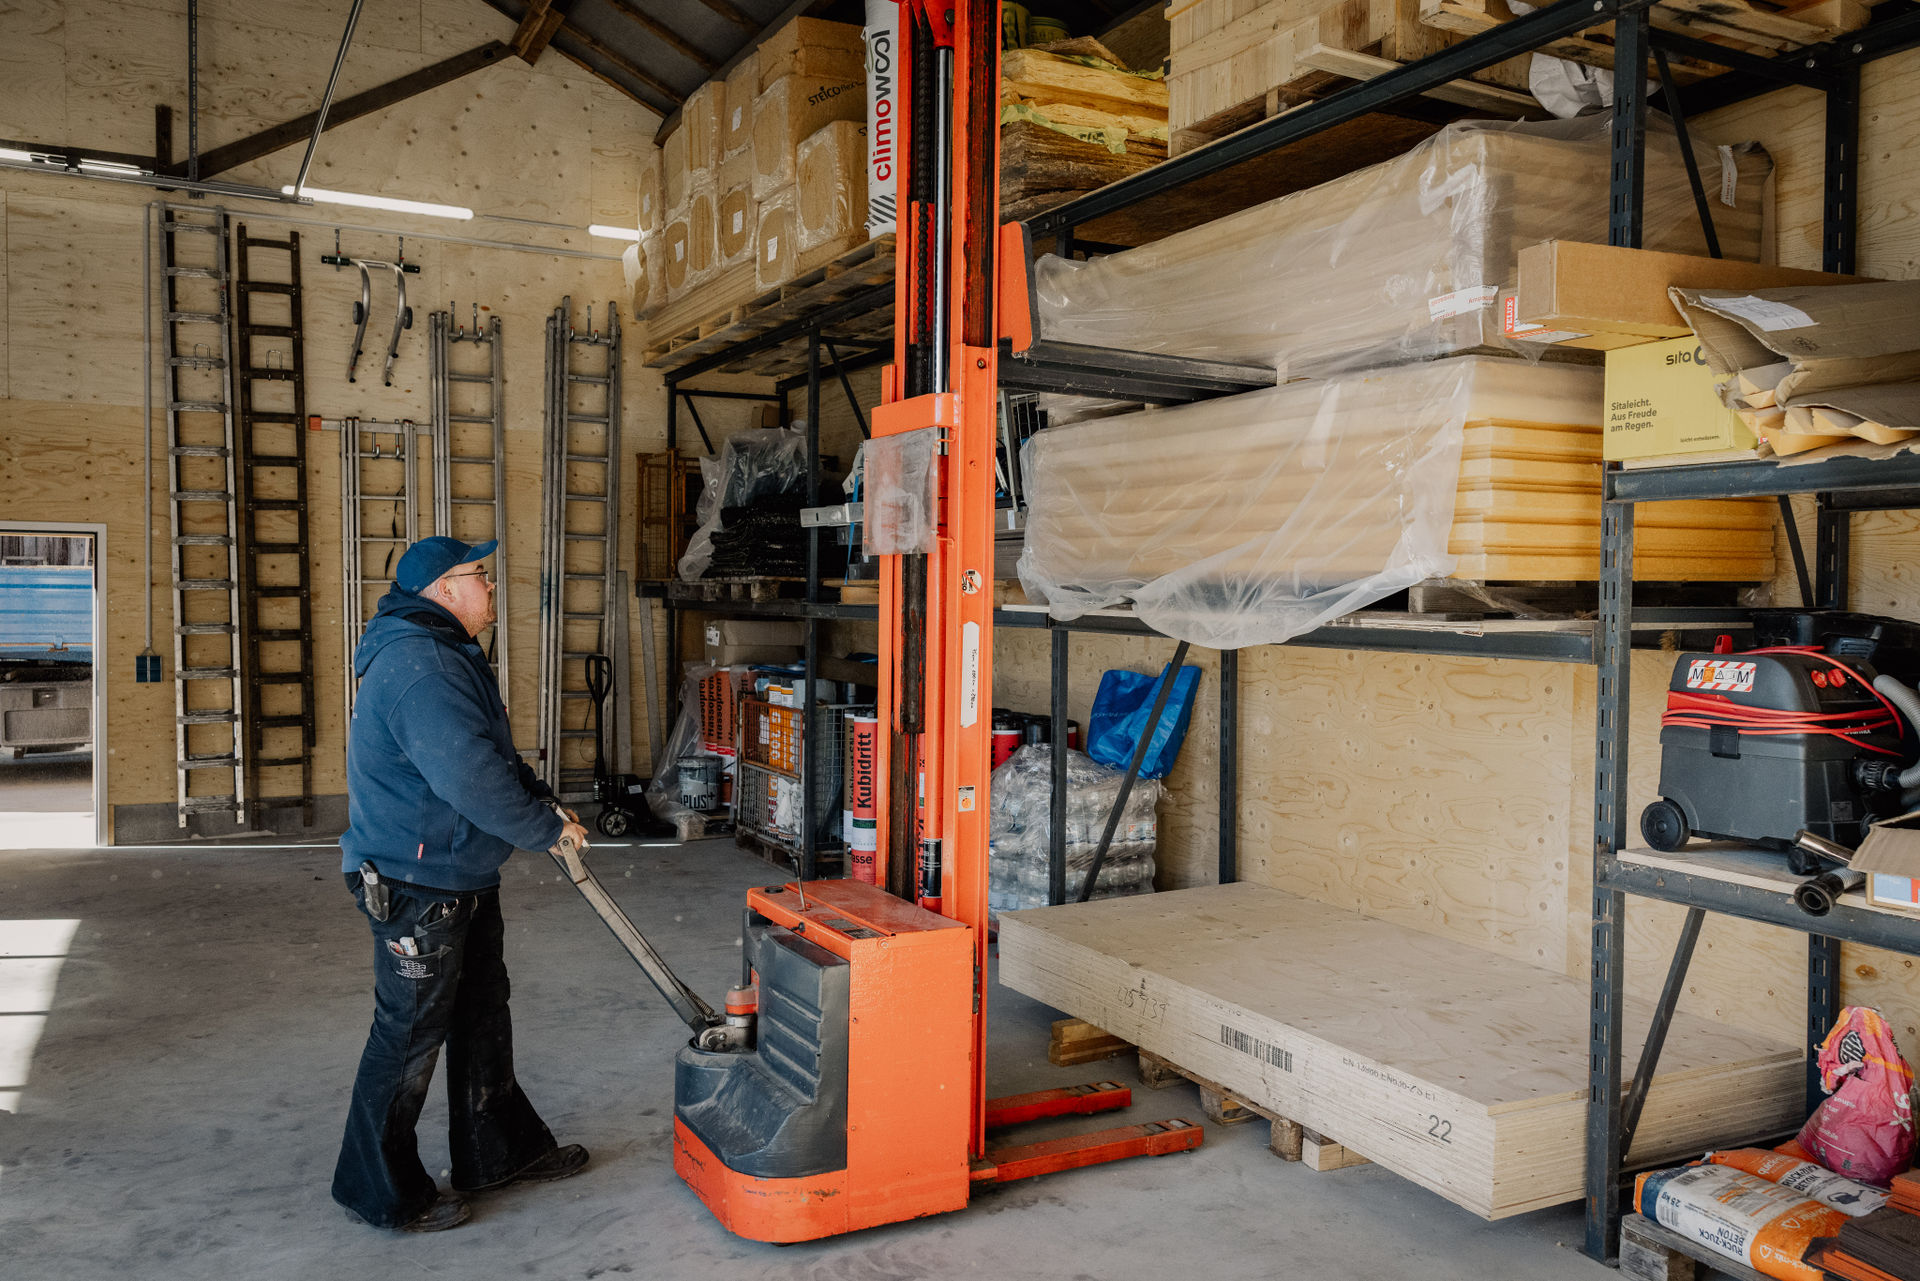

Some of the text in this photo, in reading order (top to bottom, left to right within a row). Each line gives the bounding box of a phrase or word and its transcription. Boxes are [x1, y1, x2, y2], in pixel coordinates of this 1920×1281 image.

[808, 86, 841, 106] STEICO
[871, 29, 892, 181] climowool
[1505, 298, 1514, 331] VELUX
[1611, 398, 1652, 411] Sitaleicht.
[1611, 407, 1657, 422] Aus Freude
[1610, 420, 1654, 432] am Regen.
[1693, 667, 1749, 684] M M
[857, 732, 872, 808] Kubidritt
[1428, 1114, 1452, 1145] 22
[1699, 1227, 1743, 1257] RUCK-ZUCK
[1717, 1227, 1745, 1247] BETON
